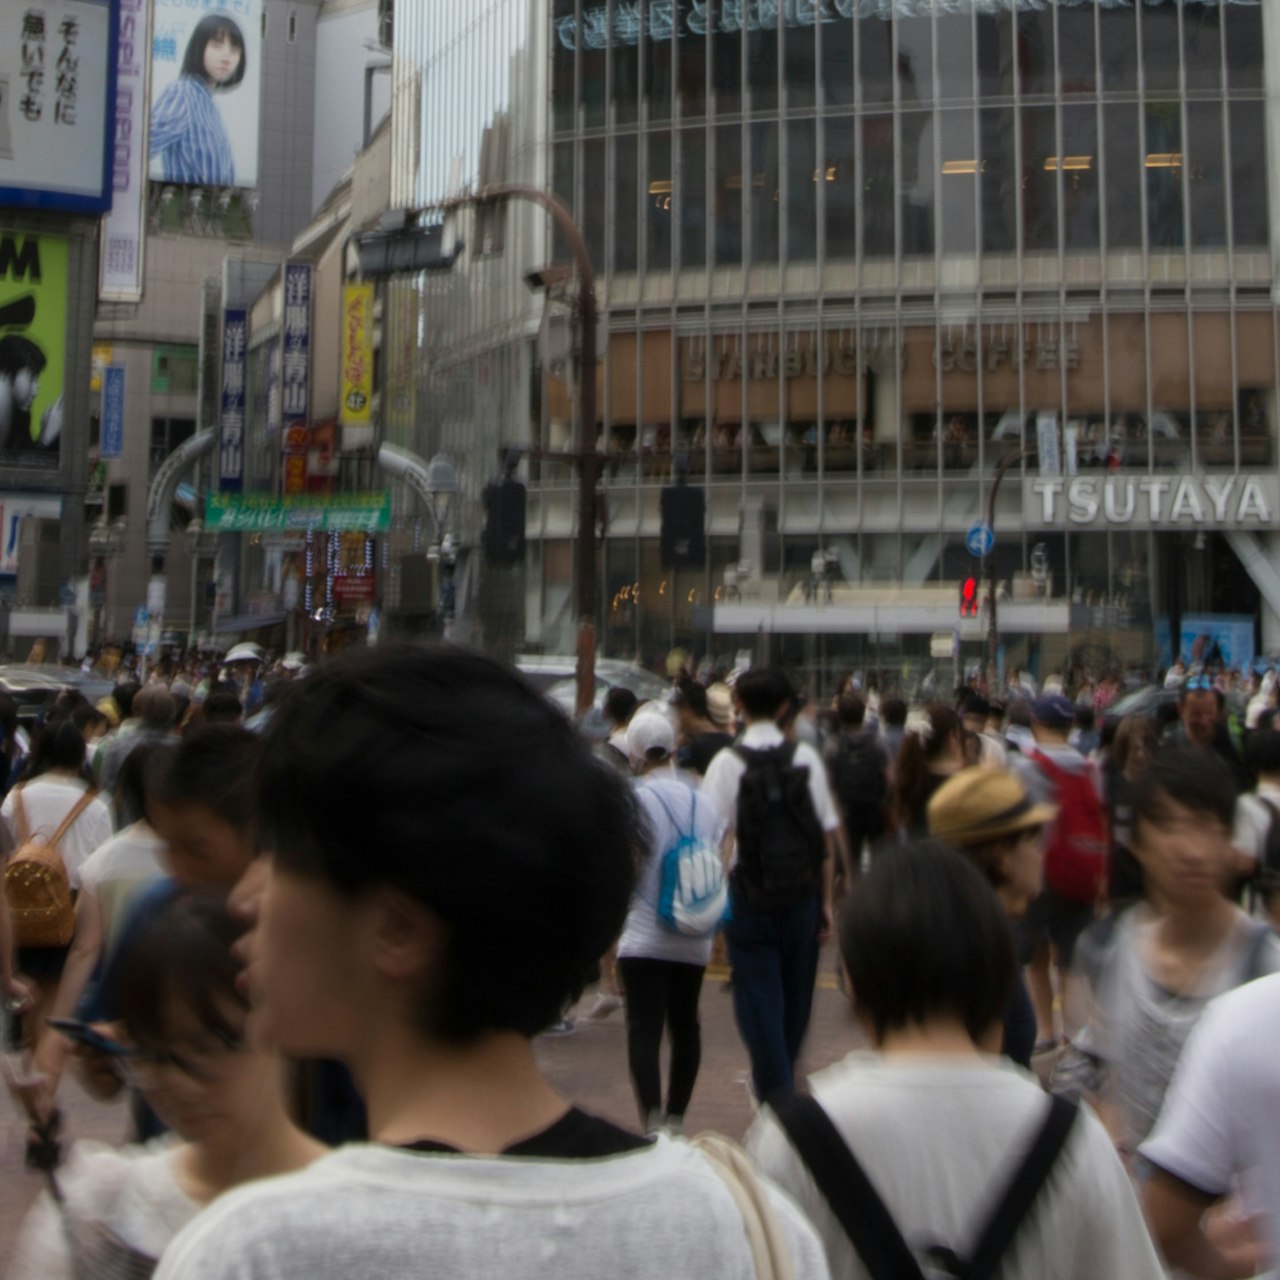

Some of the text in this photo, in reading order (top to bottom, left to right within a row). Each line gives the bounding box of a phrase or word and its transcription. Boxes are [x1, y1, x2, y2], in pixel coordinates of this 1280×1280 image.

[19, 6, 48, 123] 無いでも
[54, 14, 80, 126] そんなに
[282, 269, 309, 414] 洋服の青山
[683, 334, 1081, 383] STARBUCKS COFFEE
[220, 324, 245, 479] 洋服の青山
[1030, 475, 1272, 523] TSUTAYA
